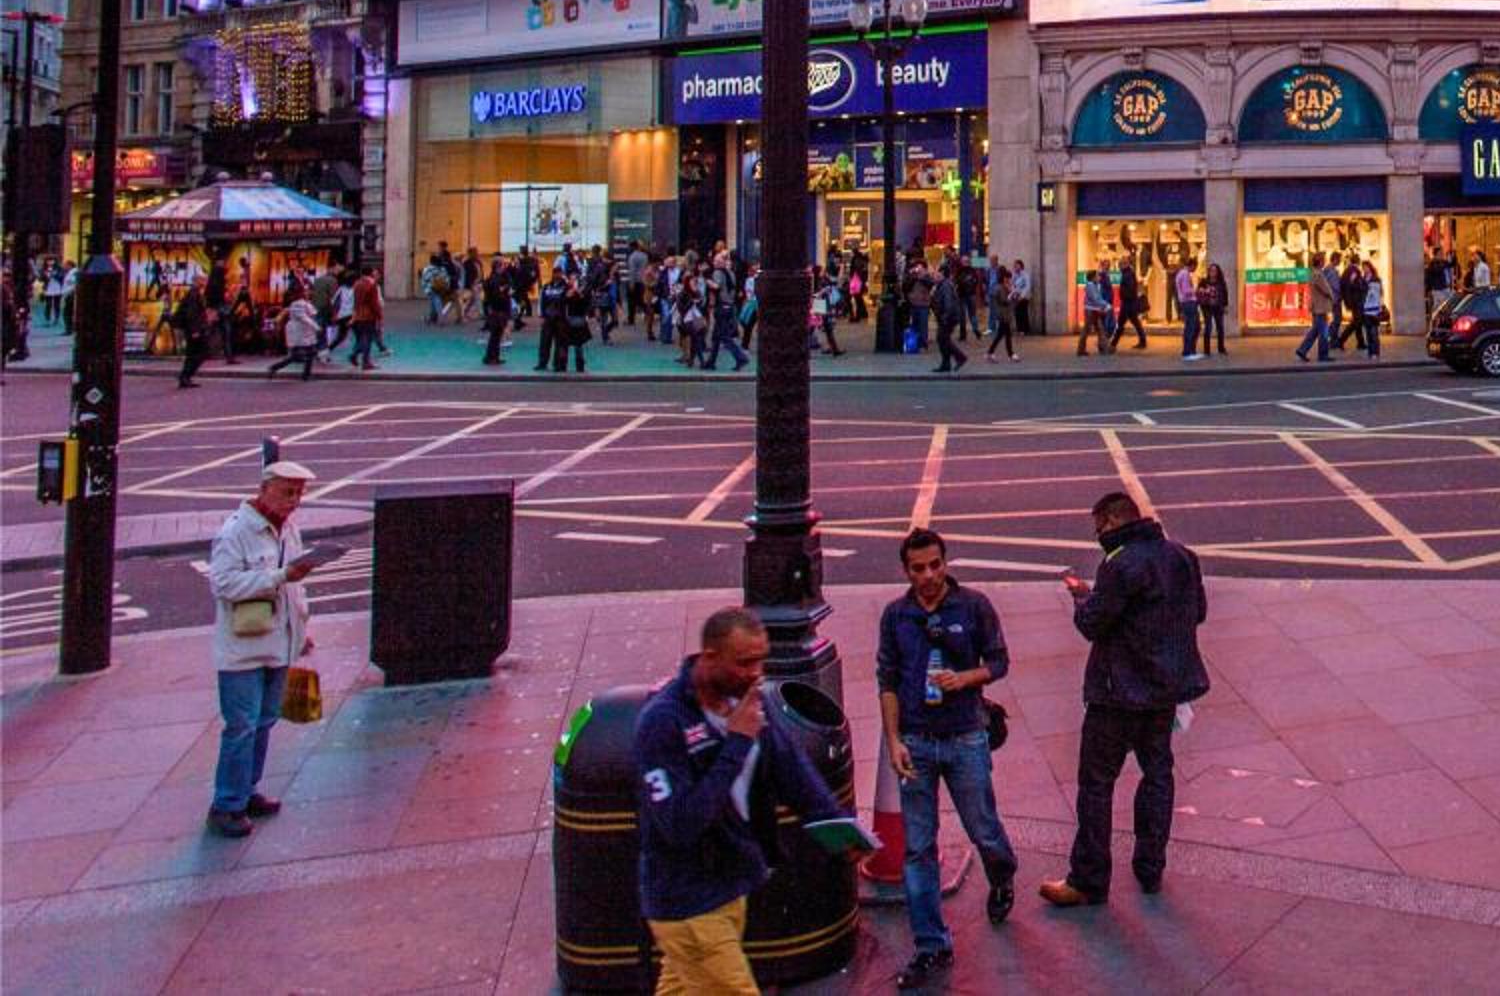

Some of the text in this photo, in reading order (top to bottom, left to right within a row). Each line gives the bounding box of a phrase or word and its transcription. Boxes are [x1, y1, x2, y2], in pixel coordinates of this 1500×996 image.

[494, 85, 585, 117] BARCLAYS
[683, 72, 763, 103] pharmac
[1294, 89, 1334, 110] GAP
[1123, 94, 1159, 116] GAP
[643, 768, 672, 802] 3
